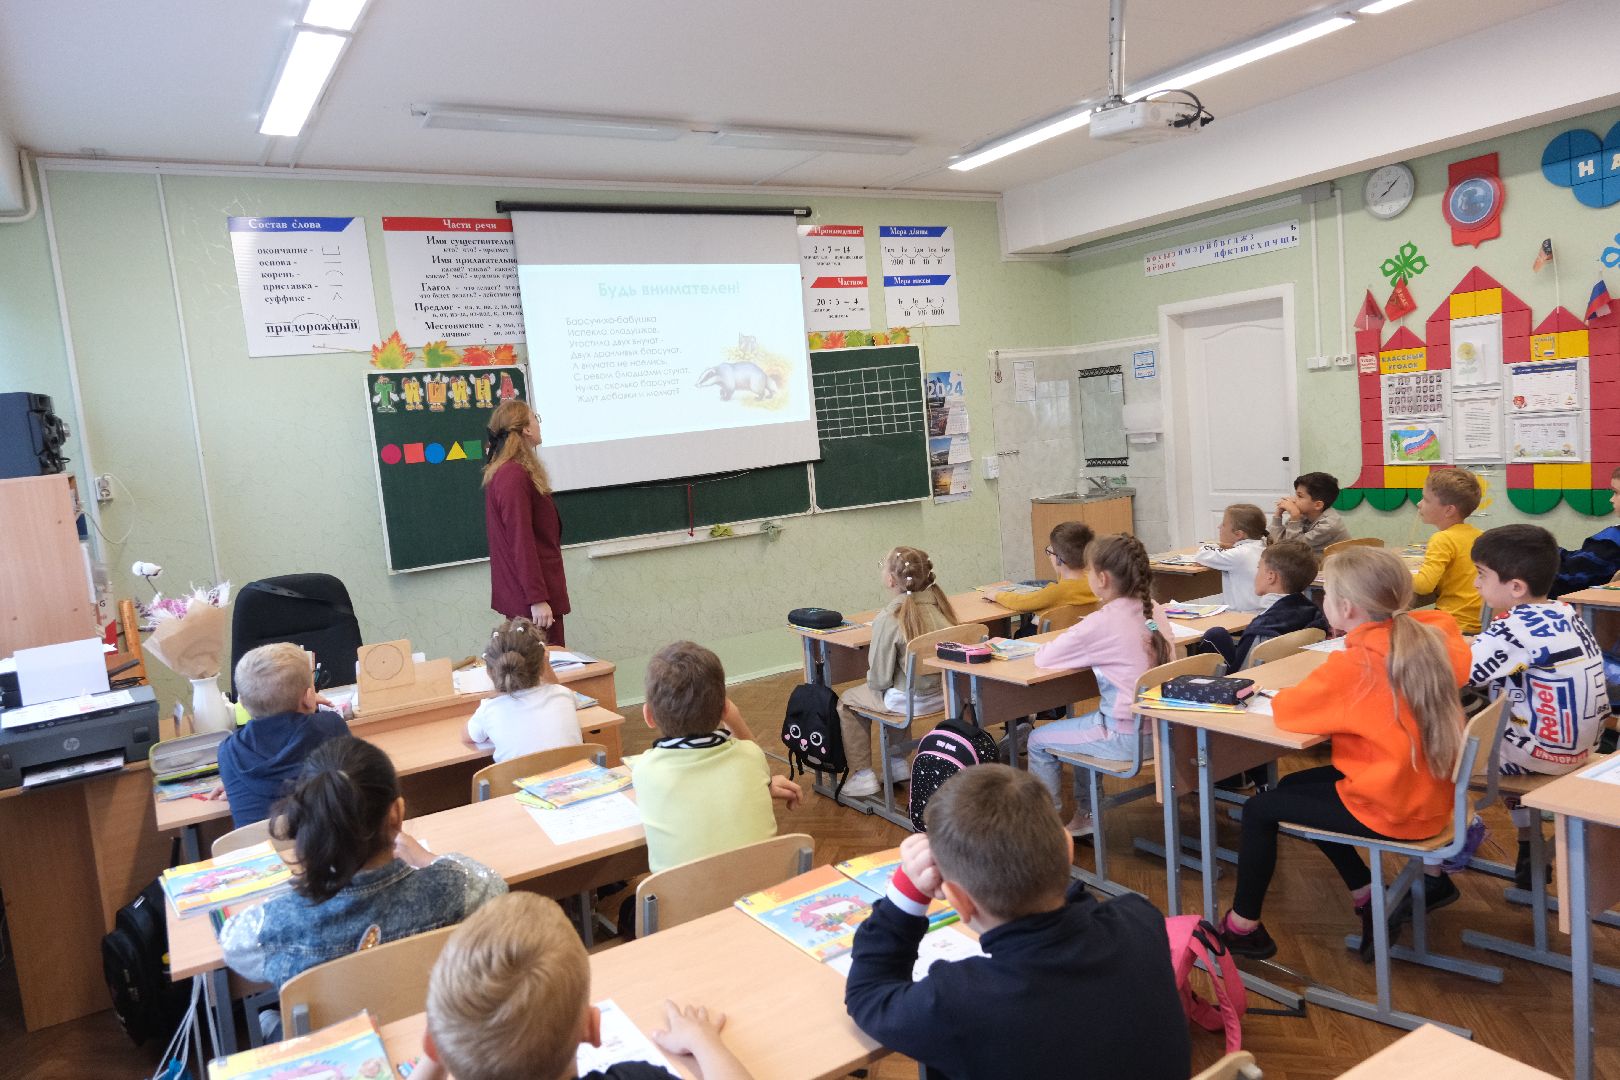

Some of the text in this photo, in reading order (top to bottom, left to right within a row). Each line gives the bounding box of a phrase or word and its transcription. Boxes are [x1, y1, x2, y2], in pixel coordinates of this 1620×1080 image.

[248, 218, 321, 229] Состав слова
[443, 218, 497, 231] Части речи
[426, 235, 447, 245] Имя
[432, 255, 452, 264] Имя
[261, 272, 296, 280] корень
[263, 283, 313, 292] приставка
[421, 282, 452, 291] Глагол
[598, 280, 741, 300] Будь внимателен!
[264, 294, 305, 304] суффикс
[414, 302, 454, 312] Предлог
[266, 319, 359, 335] придорожный
[424, 321, 484, 330] Местоимение
[567, 328, 608, 337] Испекла
[570, 351, 592, 361] Двух
[1381, 352, 1425, 363] КЛАССНЫЙ
[1389, 362, 1419, 371] УГОЛОК
[928, 380, 964, 399] 2024
[1532, 681, 1560, 744] Rebel
